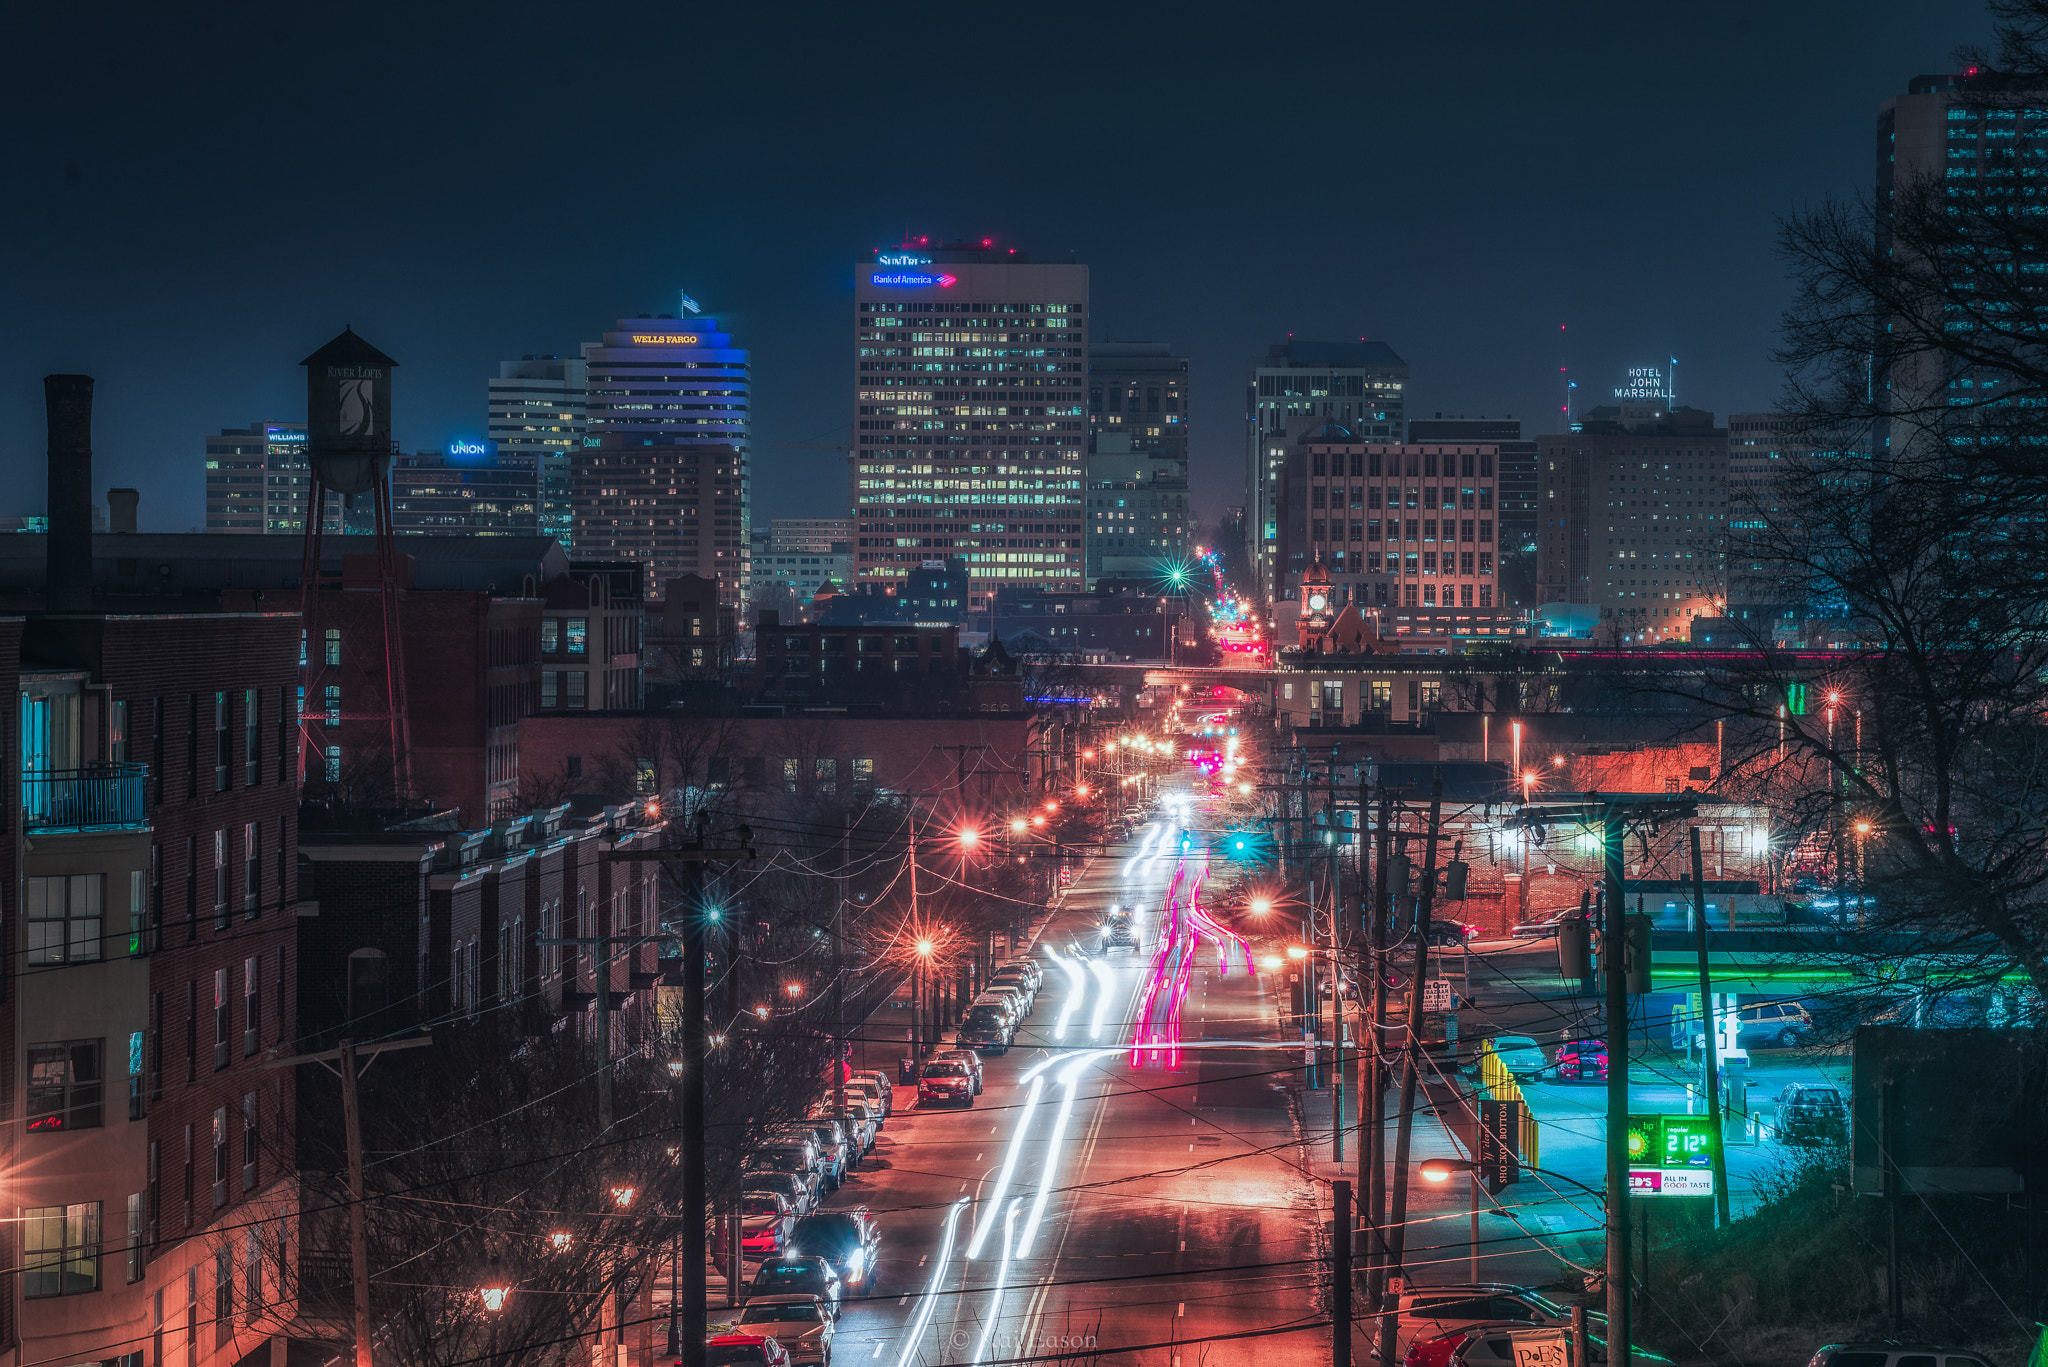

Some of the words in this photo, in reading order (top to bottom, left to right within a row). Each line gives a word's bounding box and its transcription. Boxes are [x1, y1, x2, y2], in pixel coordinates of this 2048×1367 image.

[873, 275, 892, 284] Bank
[893, 275, 901, 284] of
[902, 275, 932, 284] America
[633, 335, 665, 344] WELLS
[666, 335, 697, 344] FARGO
[327, 365, 355, 378] RIVER
[1629, 368, 1661, 377] HOTEL
[1630, 378, 1660, 387] JOHN
[1614, 388, 1675, 398] MARSHALL
[451, 444, 485, 454] UNION
[1499, 1103, 1508, 1140] BOTTOM
[1643, 1121, 1654, 1131] bp
[1482, 1123, 1495, 1163] Welcome
[1499, 1142, 1508, 1184] SHOCKOE
